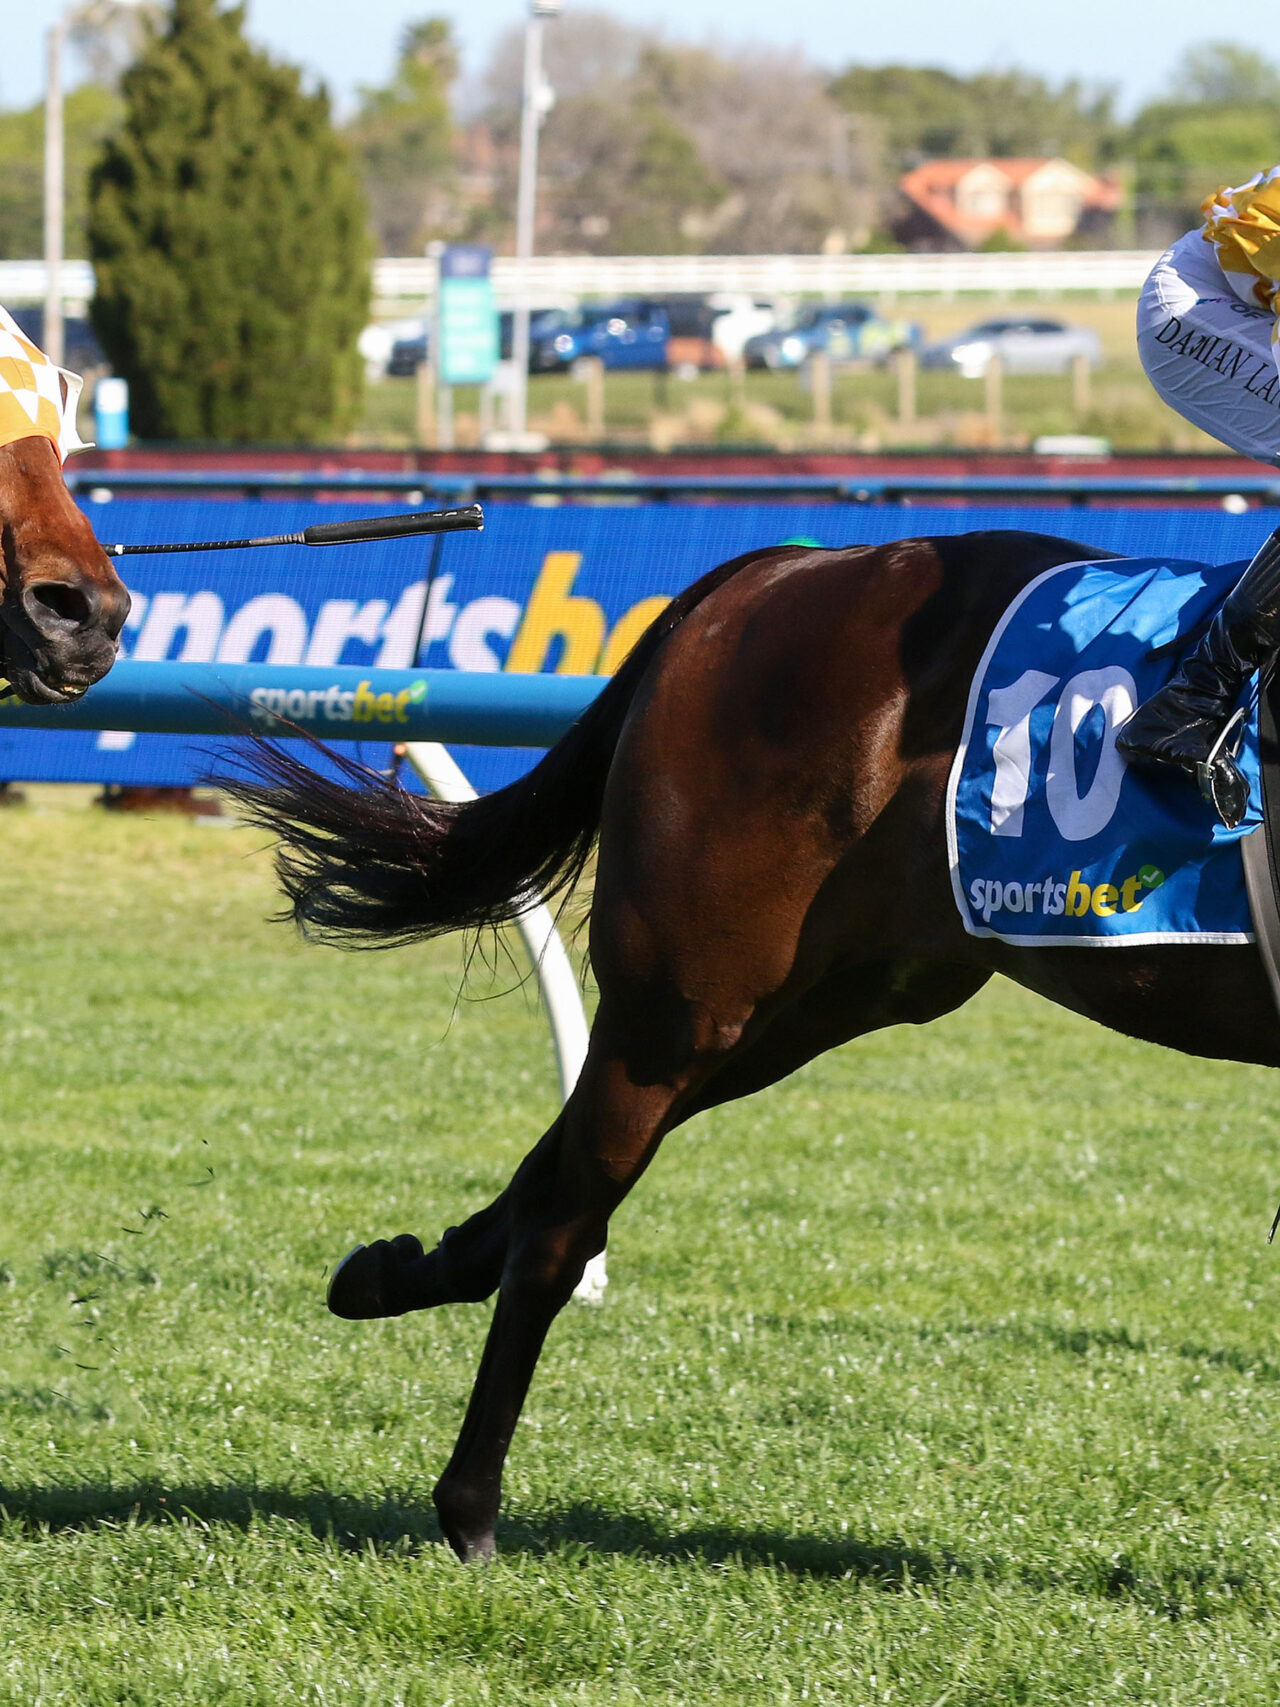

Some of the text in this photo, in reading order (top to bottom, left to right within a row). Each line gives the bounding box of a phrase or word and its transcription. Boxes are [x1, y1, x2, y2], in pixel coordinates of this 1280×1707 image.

[1155, 316, 1254, 379] DAMIAN
[250, 680, 412, 727] sportsbet
[985, 665, 1138, 841] 10
[969, 870, 1143, 922] sportsbet
